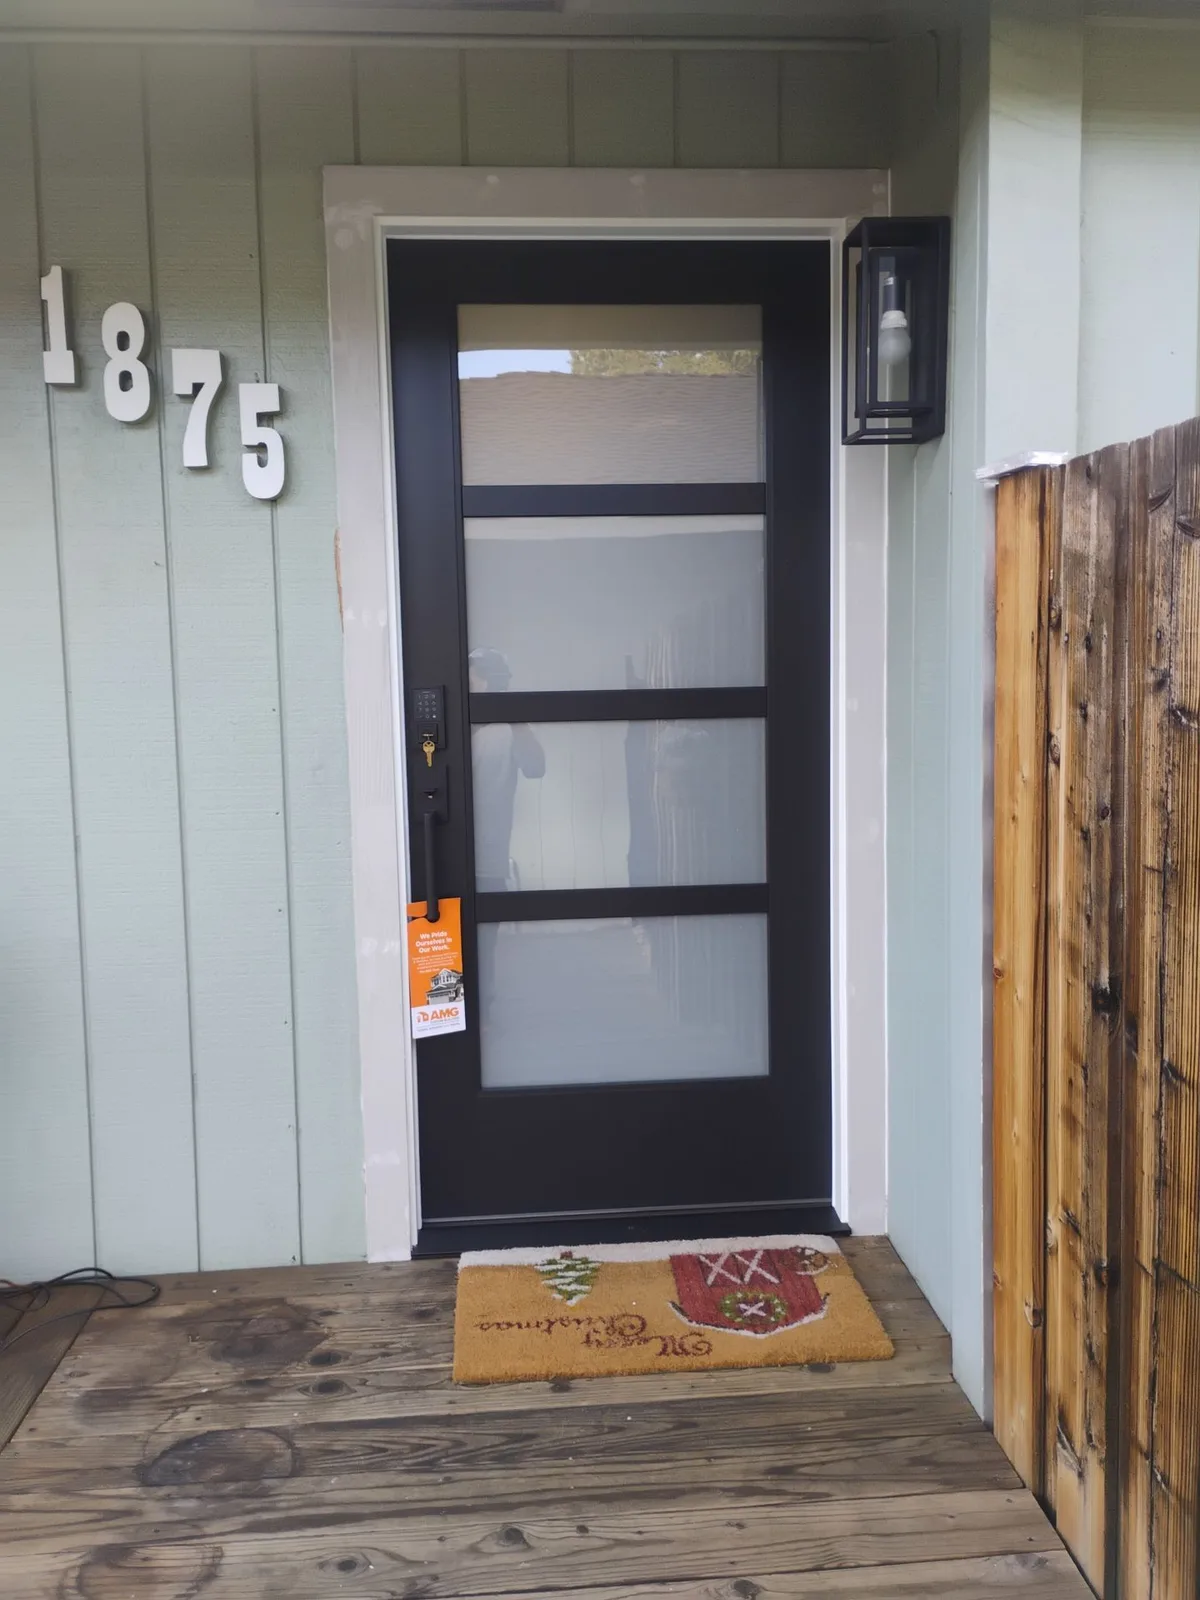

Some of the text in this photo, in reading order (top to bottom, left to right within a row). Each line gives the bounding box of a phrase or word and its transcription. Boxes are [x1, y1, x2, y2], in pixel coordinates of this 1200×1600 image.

[40, 264, 286, 500] 1875
[415, 938, 445, 947] Ourselves
[430, 1007, 460, 1021] AMG
[474, 1312, 649, 1338] Christmas
[582, 1330, 714, 1357] Merry
